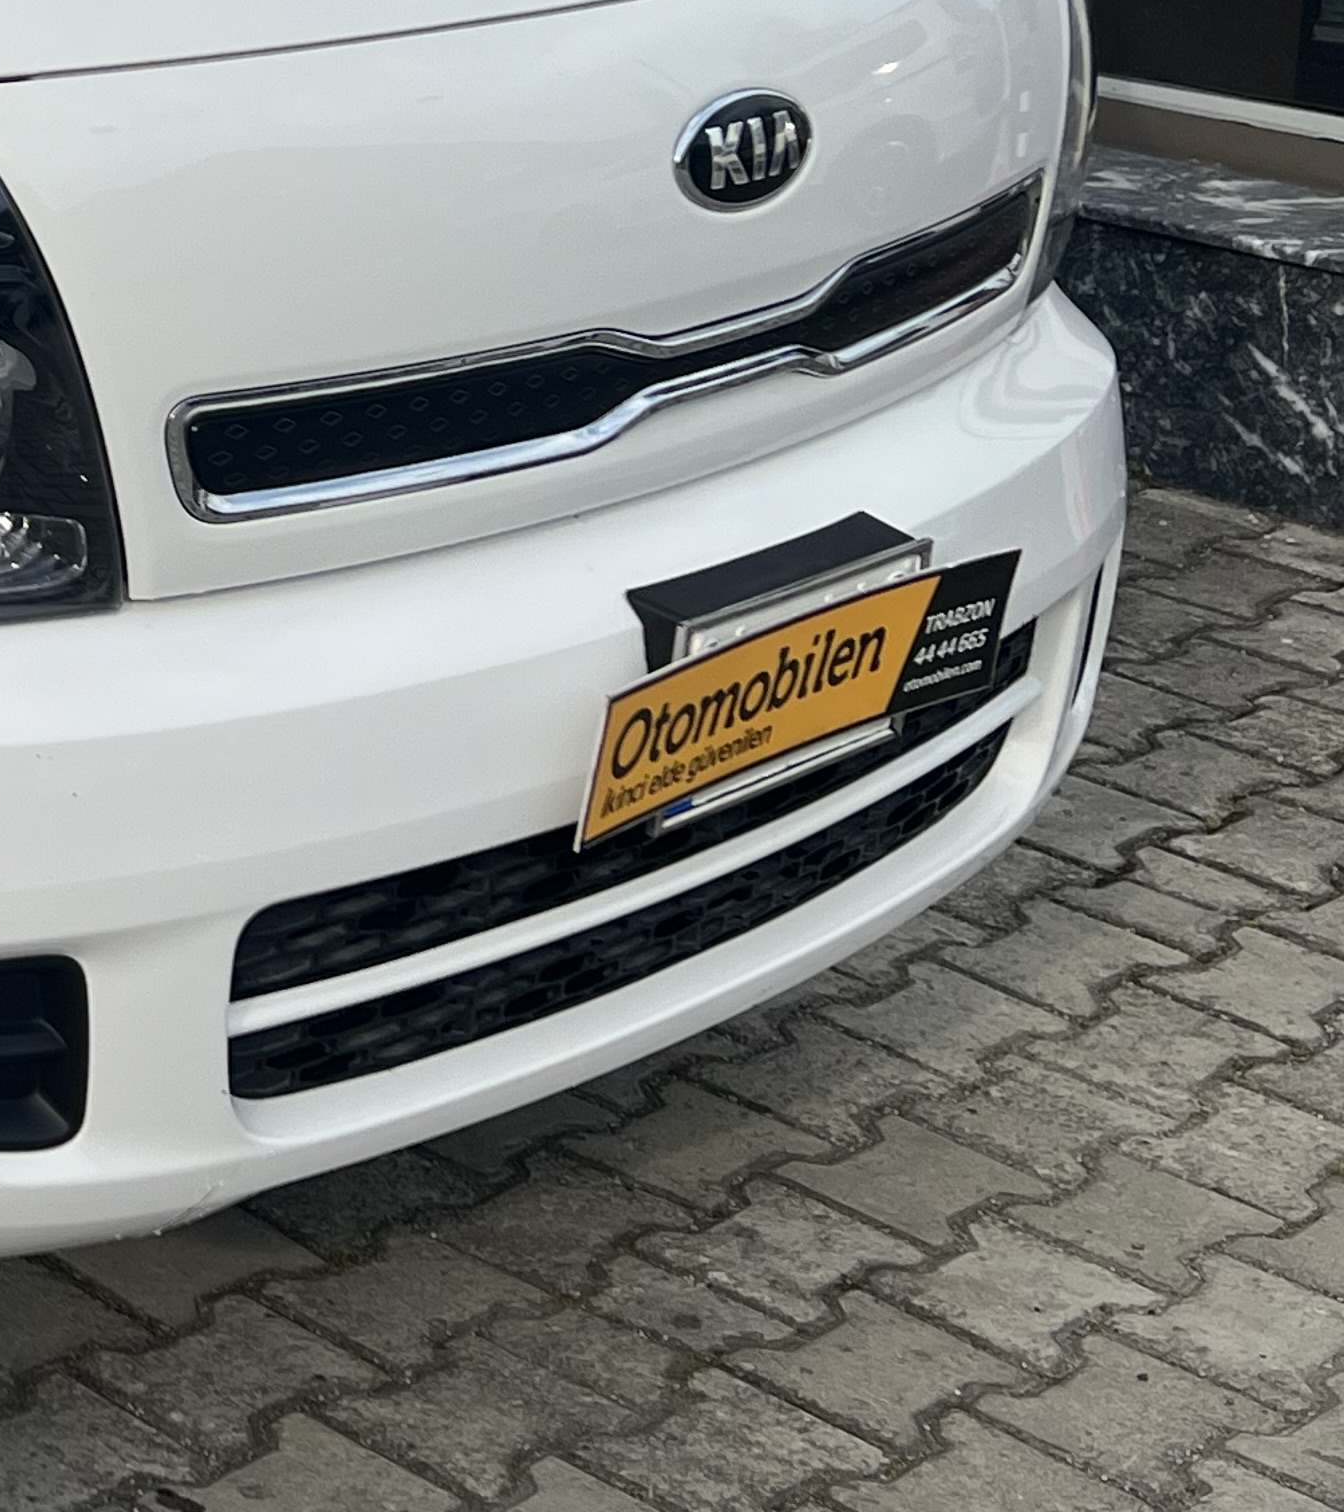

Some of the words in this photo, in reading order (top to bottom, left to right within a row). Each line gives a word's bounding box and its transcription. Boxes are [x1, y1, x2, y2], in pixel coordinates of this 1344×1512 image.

[704, 110, 801, 190] KIA
[924, 597, 996, 635] TRABZON
[612, 626, 887, 780] Otomobilen
